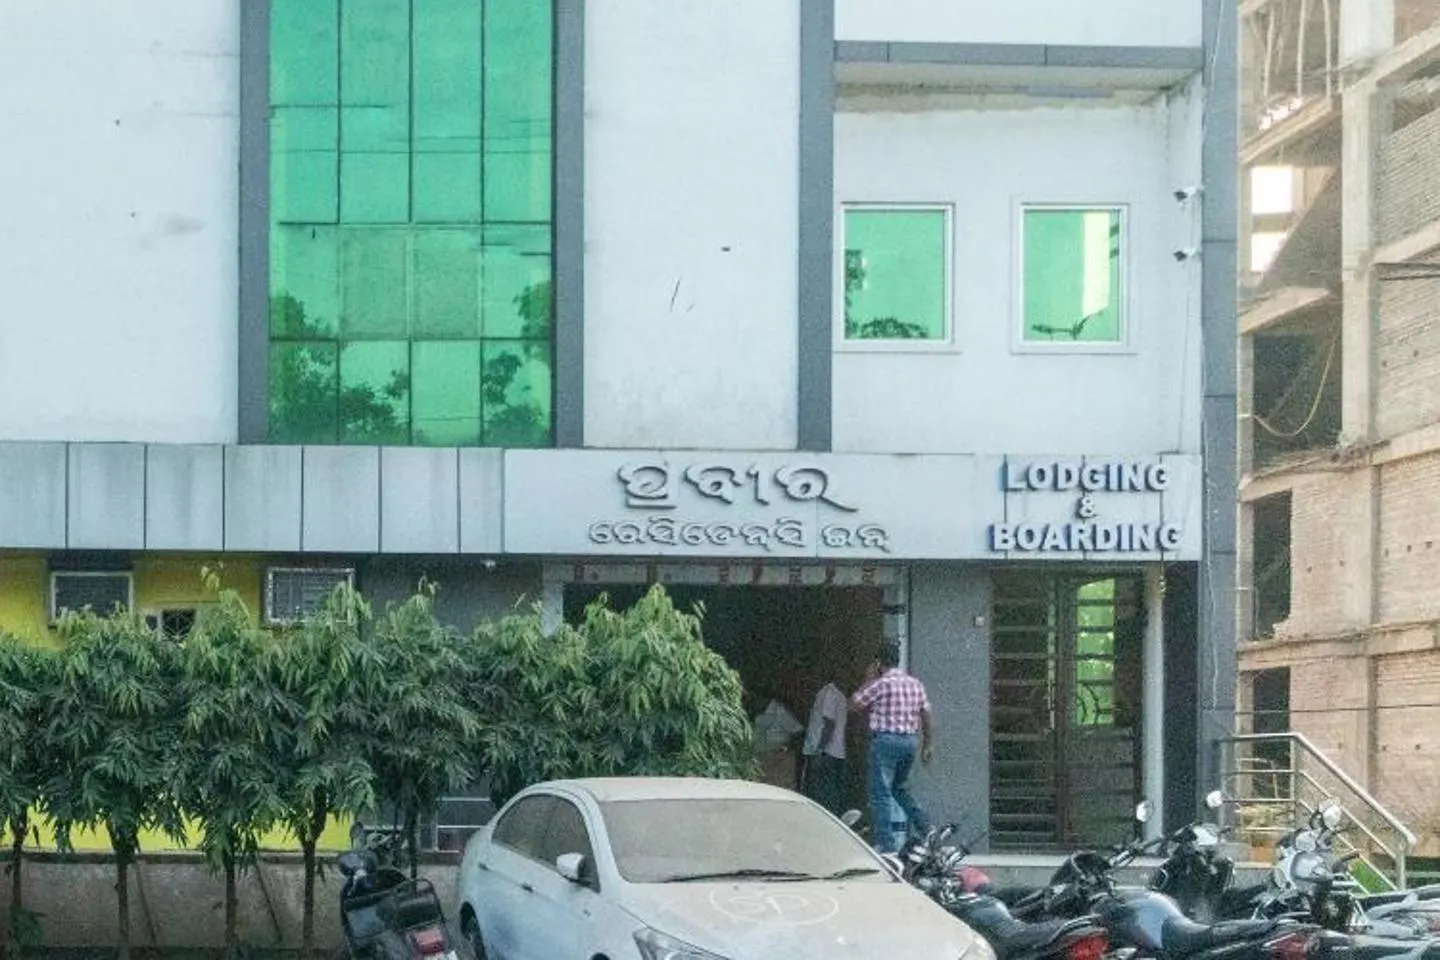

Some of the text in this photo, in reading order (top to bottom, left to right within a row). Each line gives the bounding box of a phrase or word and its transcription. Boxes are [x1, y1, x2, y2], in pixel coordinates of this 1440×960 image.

[998, 461, 1172, 492] LODGING
[1075, 494, 1097, 519] &
[987, 523, 1183, 552] BOARDING
